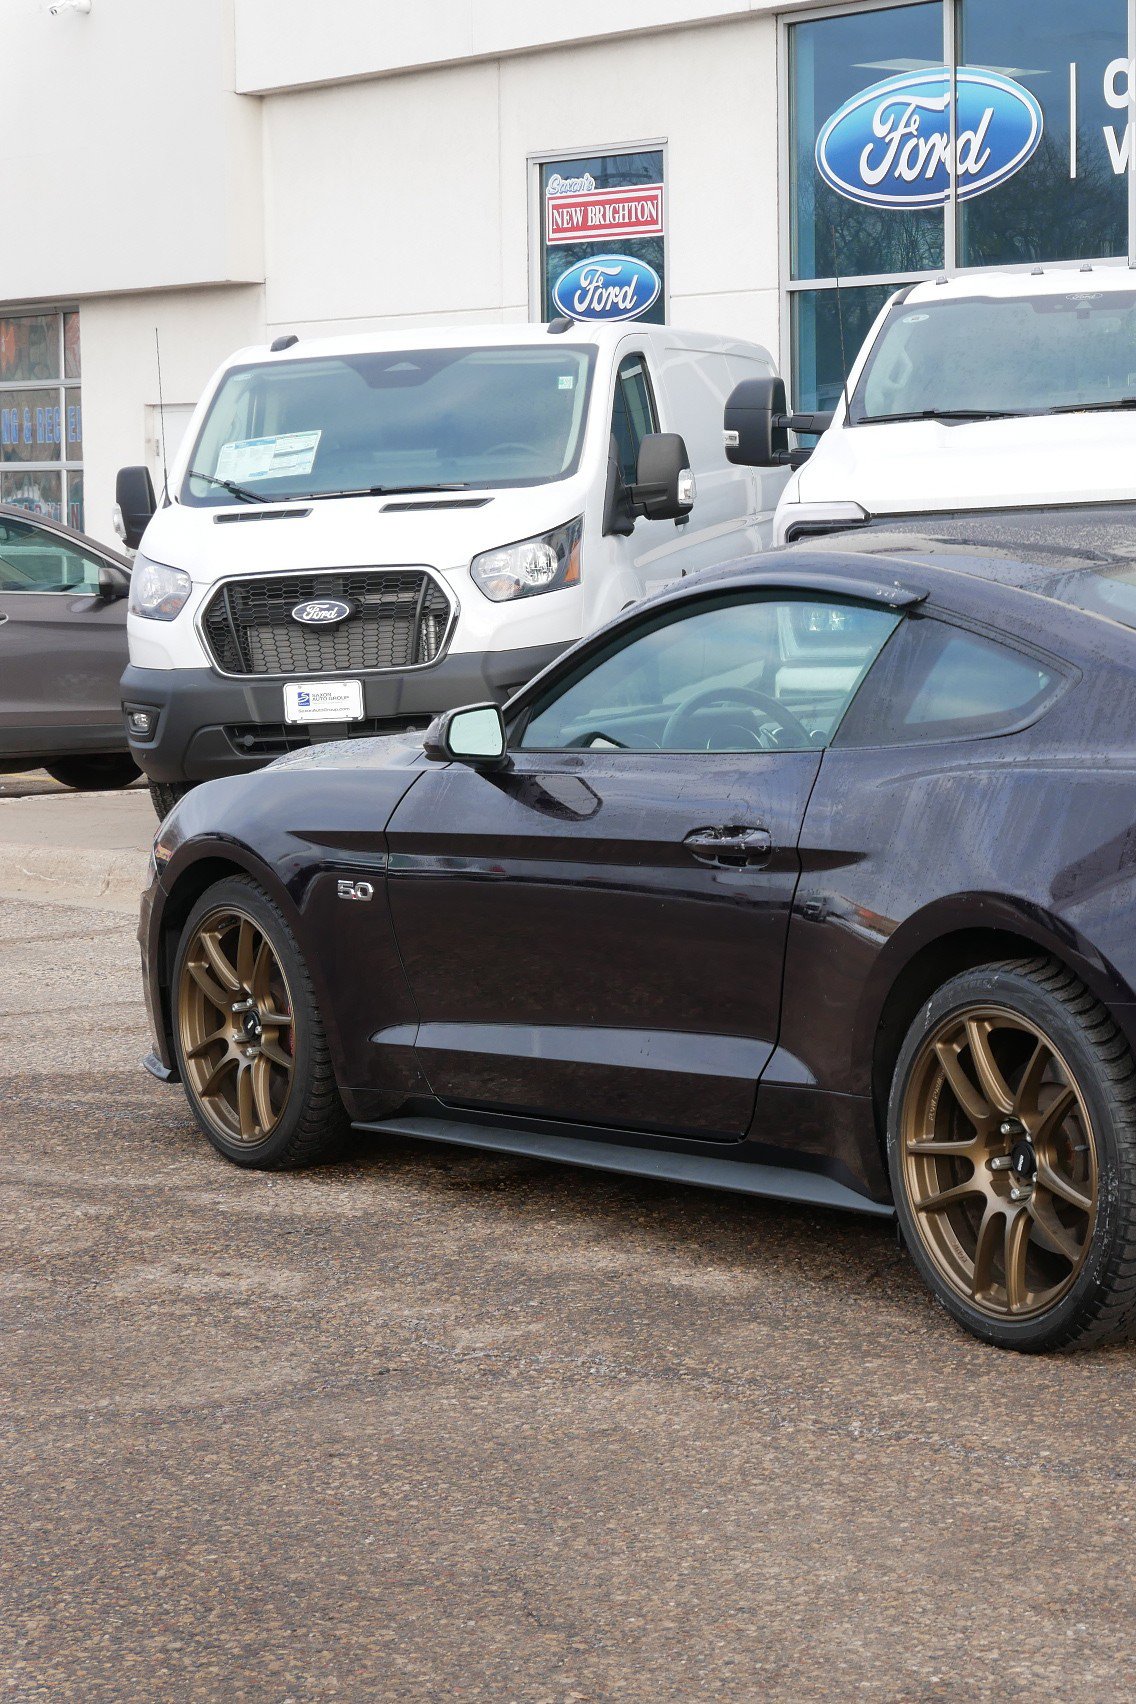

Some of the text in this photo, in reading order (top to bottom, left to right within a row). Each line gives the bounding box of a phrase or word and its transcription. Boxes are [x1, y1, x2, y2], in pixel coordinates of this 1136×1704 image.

[859, 91, 995, 187] Ford
[547, 173, 595, 196] Saxon's
[552, 200, 658, 229] NEW BRIGHTON
[573, 265, 639, 313] Ford
[303, 604, 338, 619] Ford
[337, 879, 374, 902] 5.0
